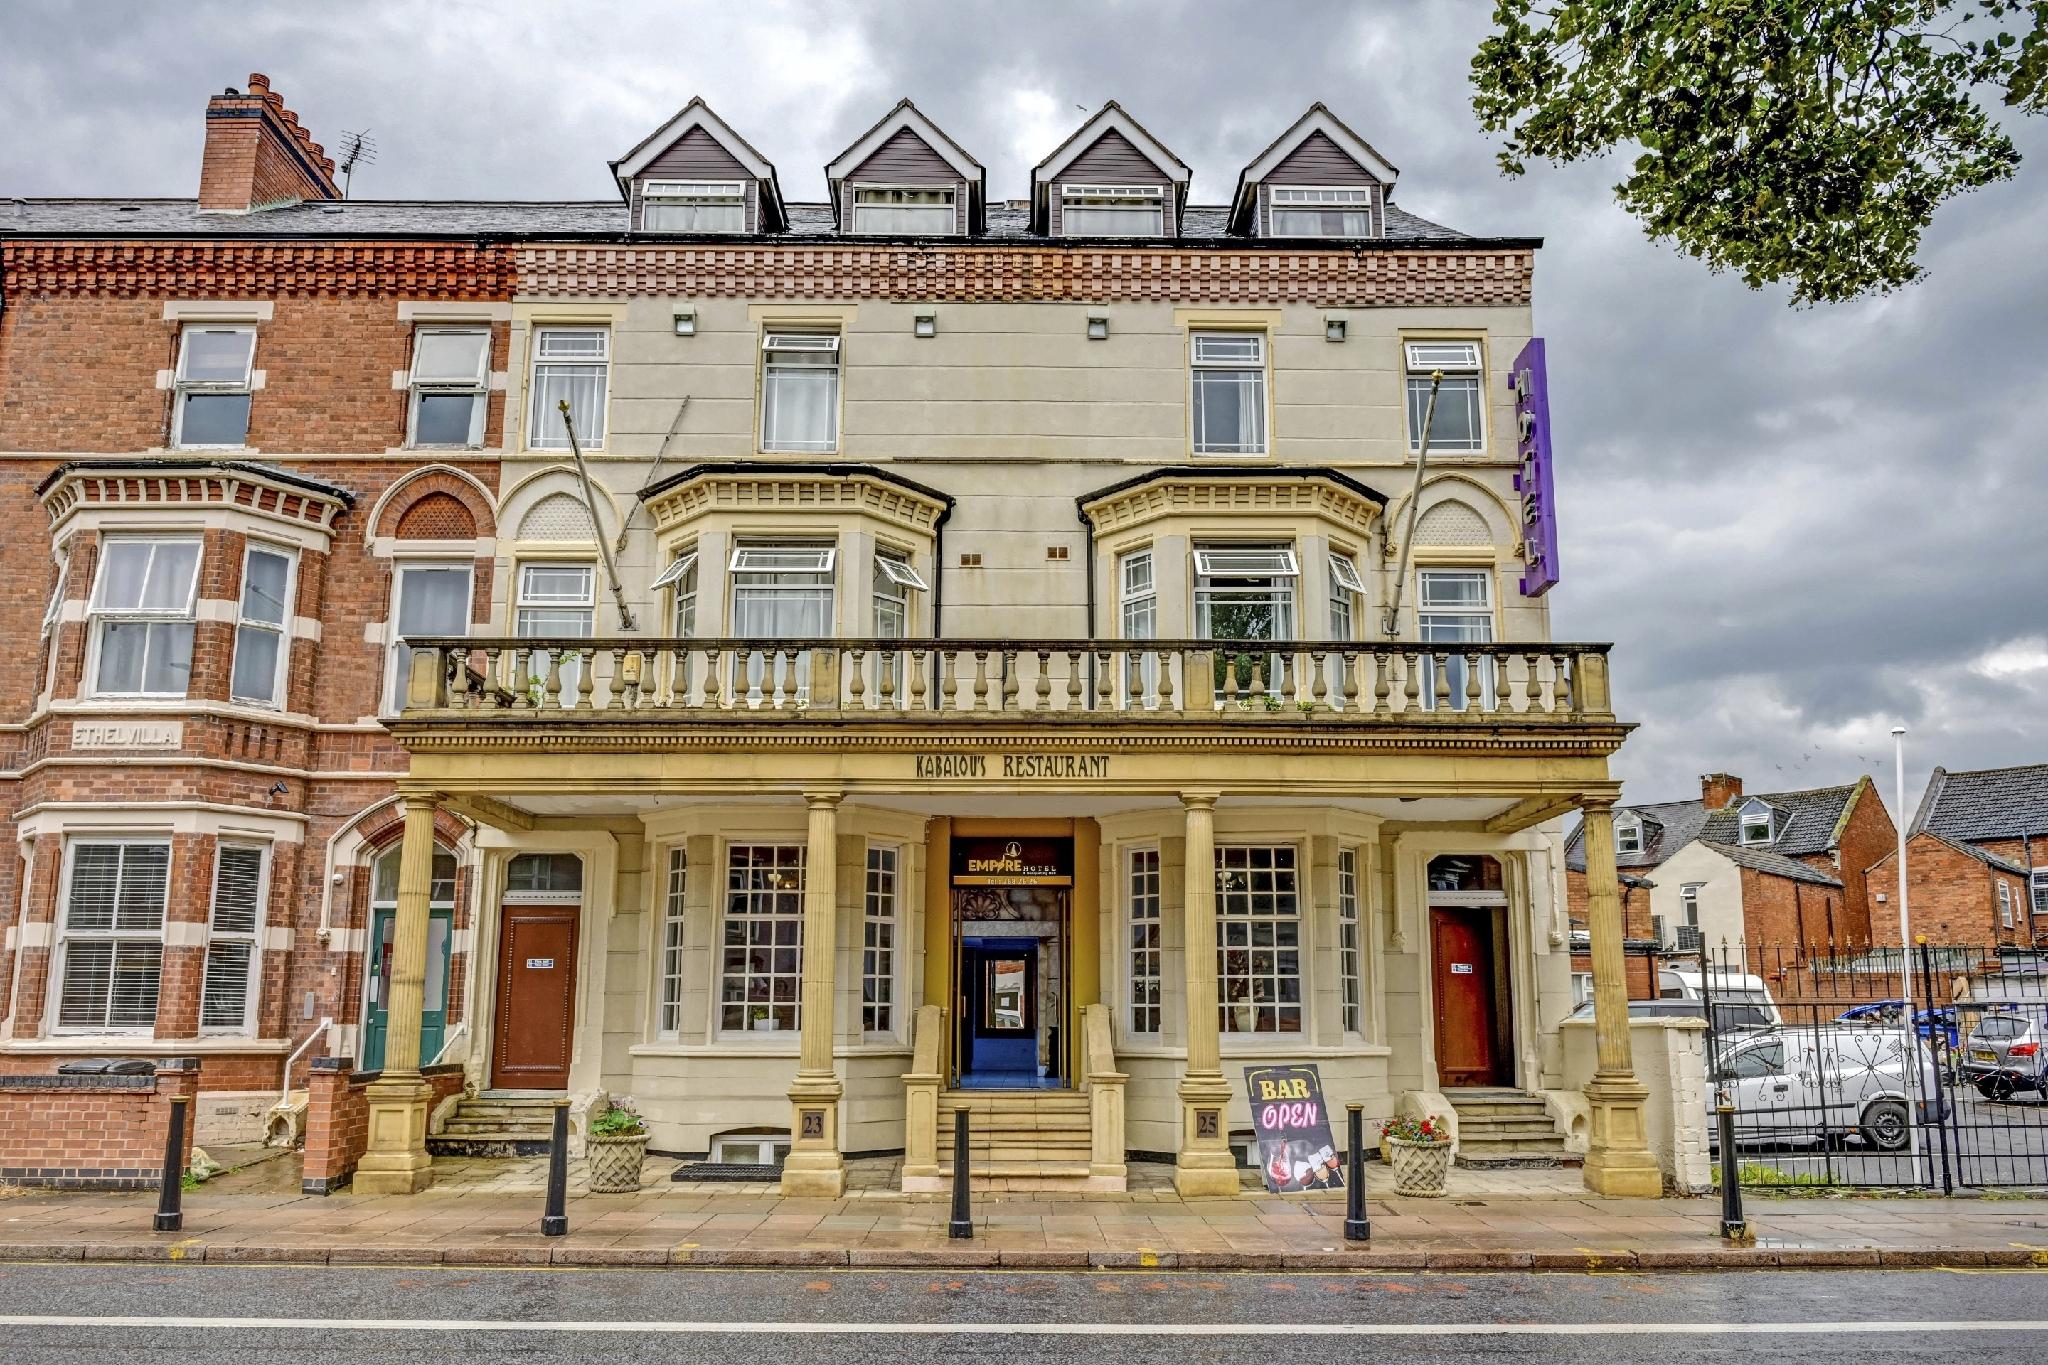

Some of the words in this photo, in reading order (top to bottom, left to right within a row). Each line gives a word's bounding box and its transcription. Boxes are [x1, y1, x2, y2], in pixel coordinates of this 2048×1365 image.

[73, 727, 126, 745] ETHEL
[128, 727, 179, 745] VILLA
[1003, 754, 1110, 778] RESTAURANT
[968, 857, 1022, 873] EMPIRE
[1258, 1078, 1311, 1100] BAR
[803, 1115, 822, 1134] 23
[1199, 1115, 1217, 1134] 25
[1262, 1102, 1318, 1129] OPEN
